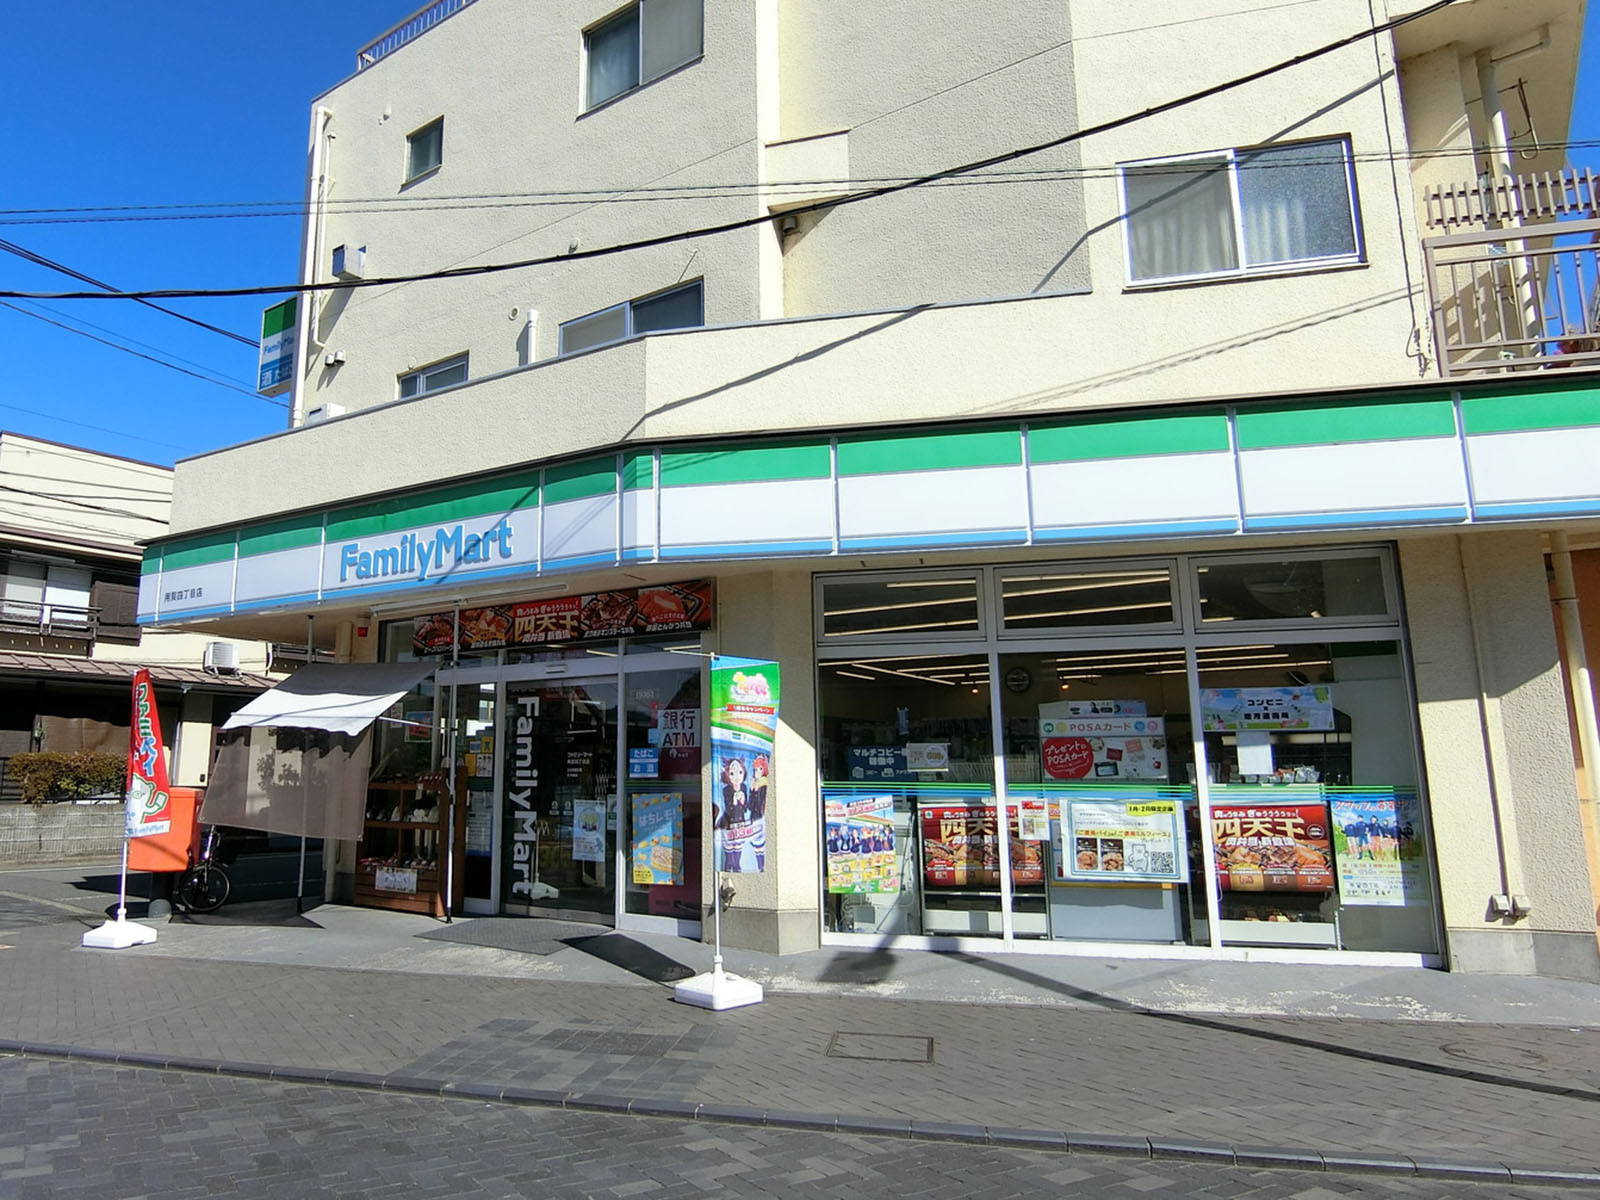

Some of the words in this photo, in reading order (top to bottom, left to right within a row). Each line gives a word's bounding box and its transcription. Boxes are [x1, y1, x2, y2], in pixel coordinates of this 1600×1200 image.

[339, 518, 513, 582] FamilyMart
[138, 683, 157, 778] ファミペイ
[662, 710, 696, 730] 銀行
[1069, 722, 1132, 732] POSAカード
[662, 732, 696, 747] ATM
[633, 749, 654, 759] たばこ
[509, 696, 541, 895] FamilyMart
[1213, 817, 1305, 847] 四天王
